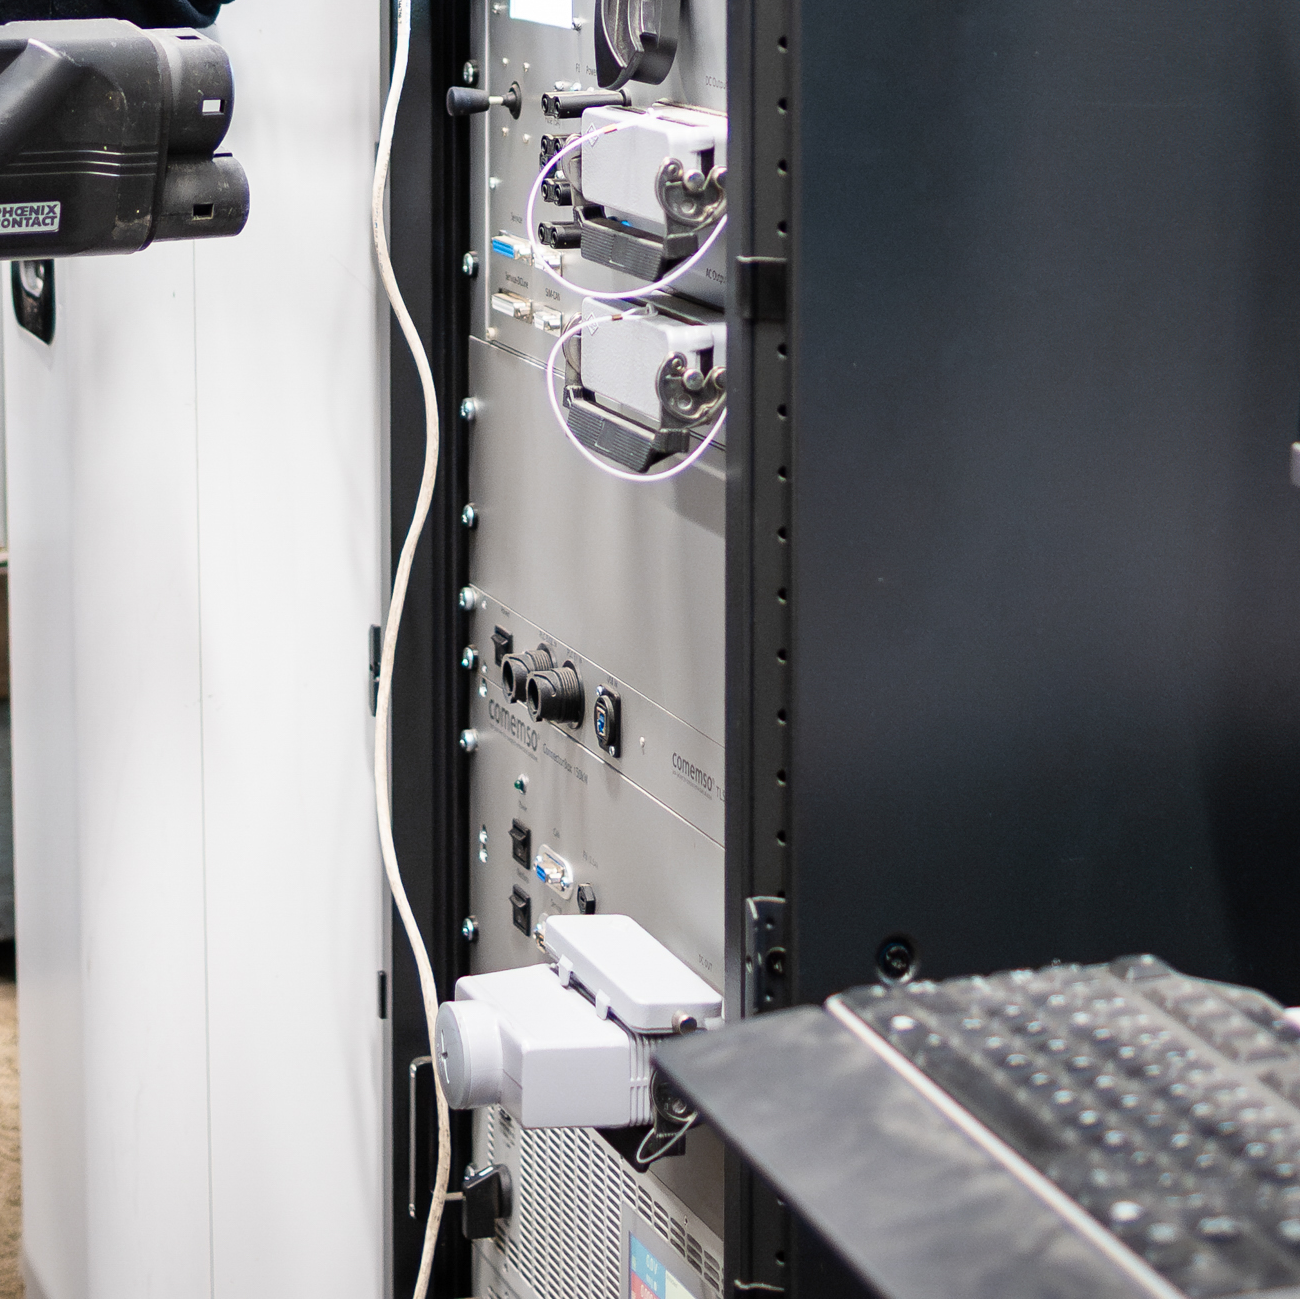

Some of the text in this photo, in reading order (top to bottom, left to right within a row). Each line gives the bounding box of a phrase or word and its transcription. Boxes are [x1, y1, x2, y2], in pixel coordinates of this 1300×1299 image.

[586, 65, 597, 76] Powe
[489, 699, 538, 752] comemso
[672, 752, 712, 792] comemso
